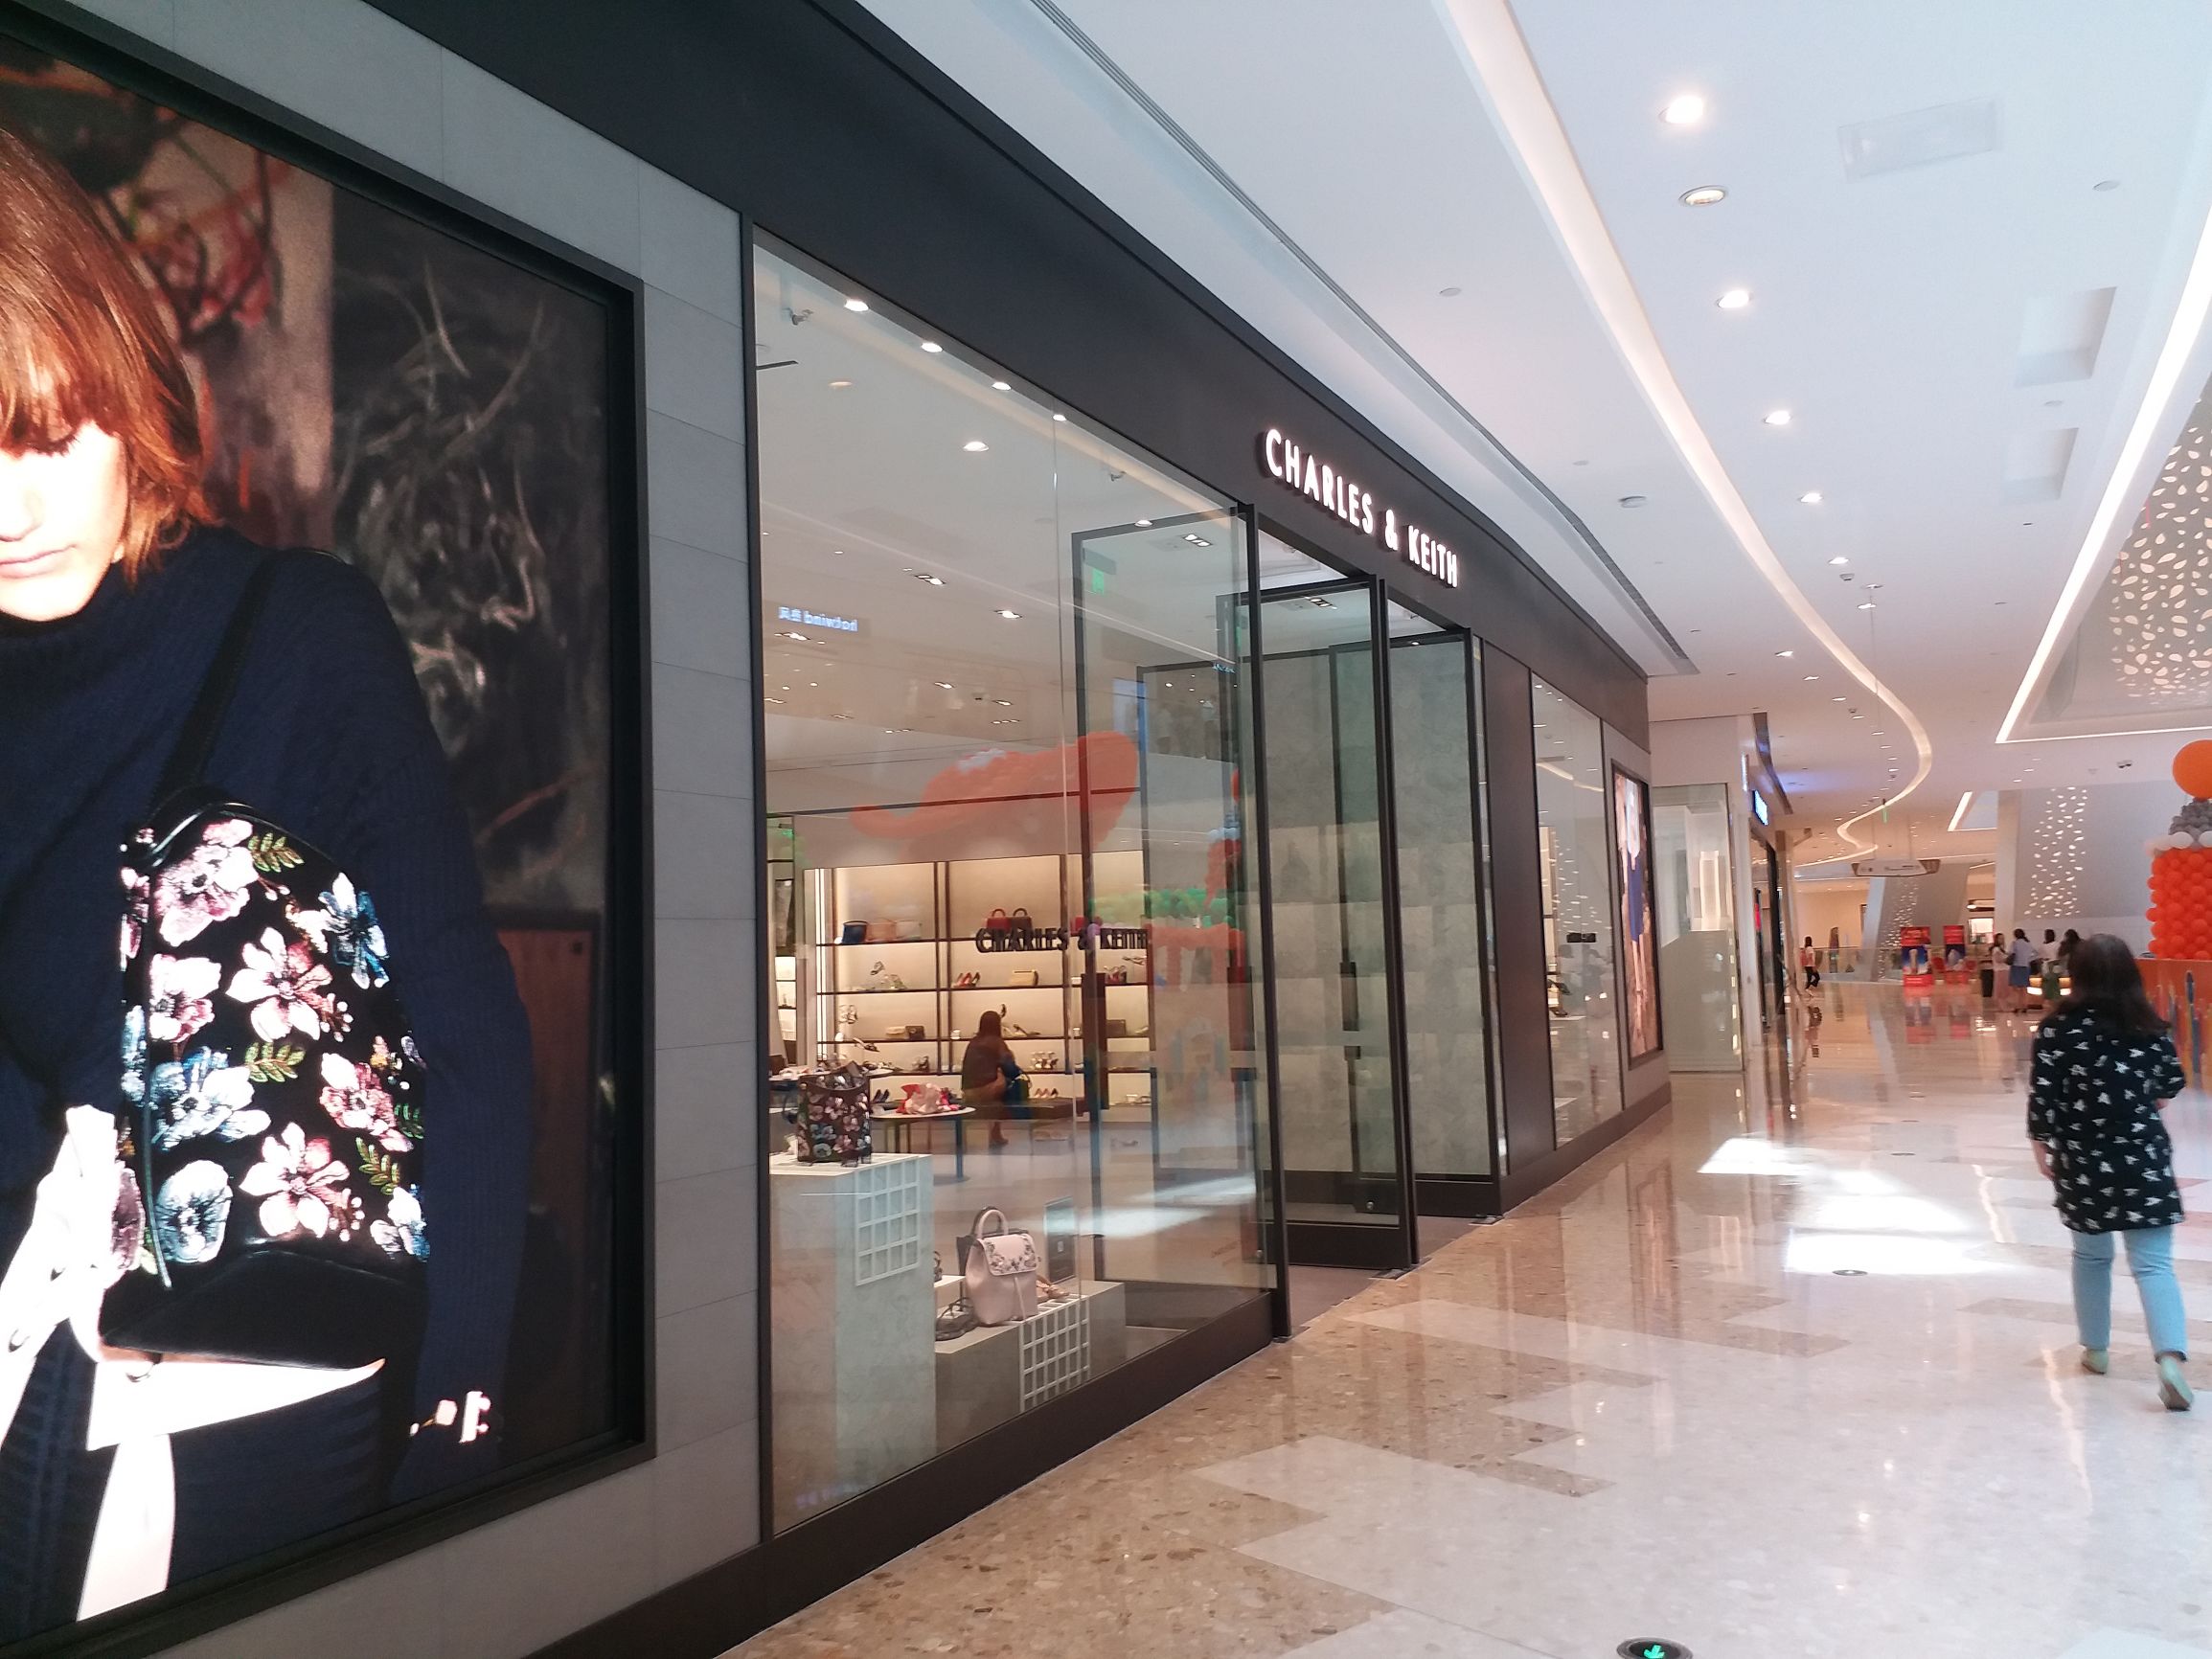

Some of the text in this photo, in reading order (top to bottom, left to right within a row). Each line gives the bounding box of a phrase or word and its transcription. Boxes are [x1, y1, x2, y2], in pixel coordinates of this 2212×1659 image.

[1265, 427, 1458, 589] CHARLES & KEITH
